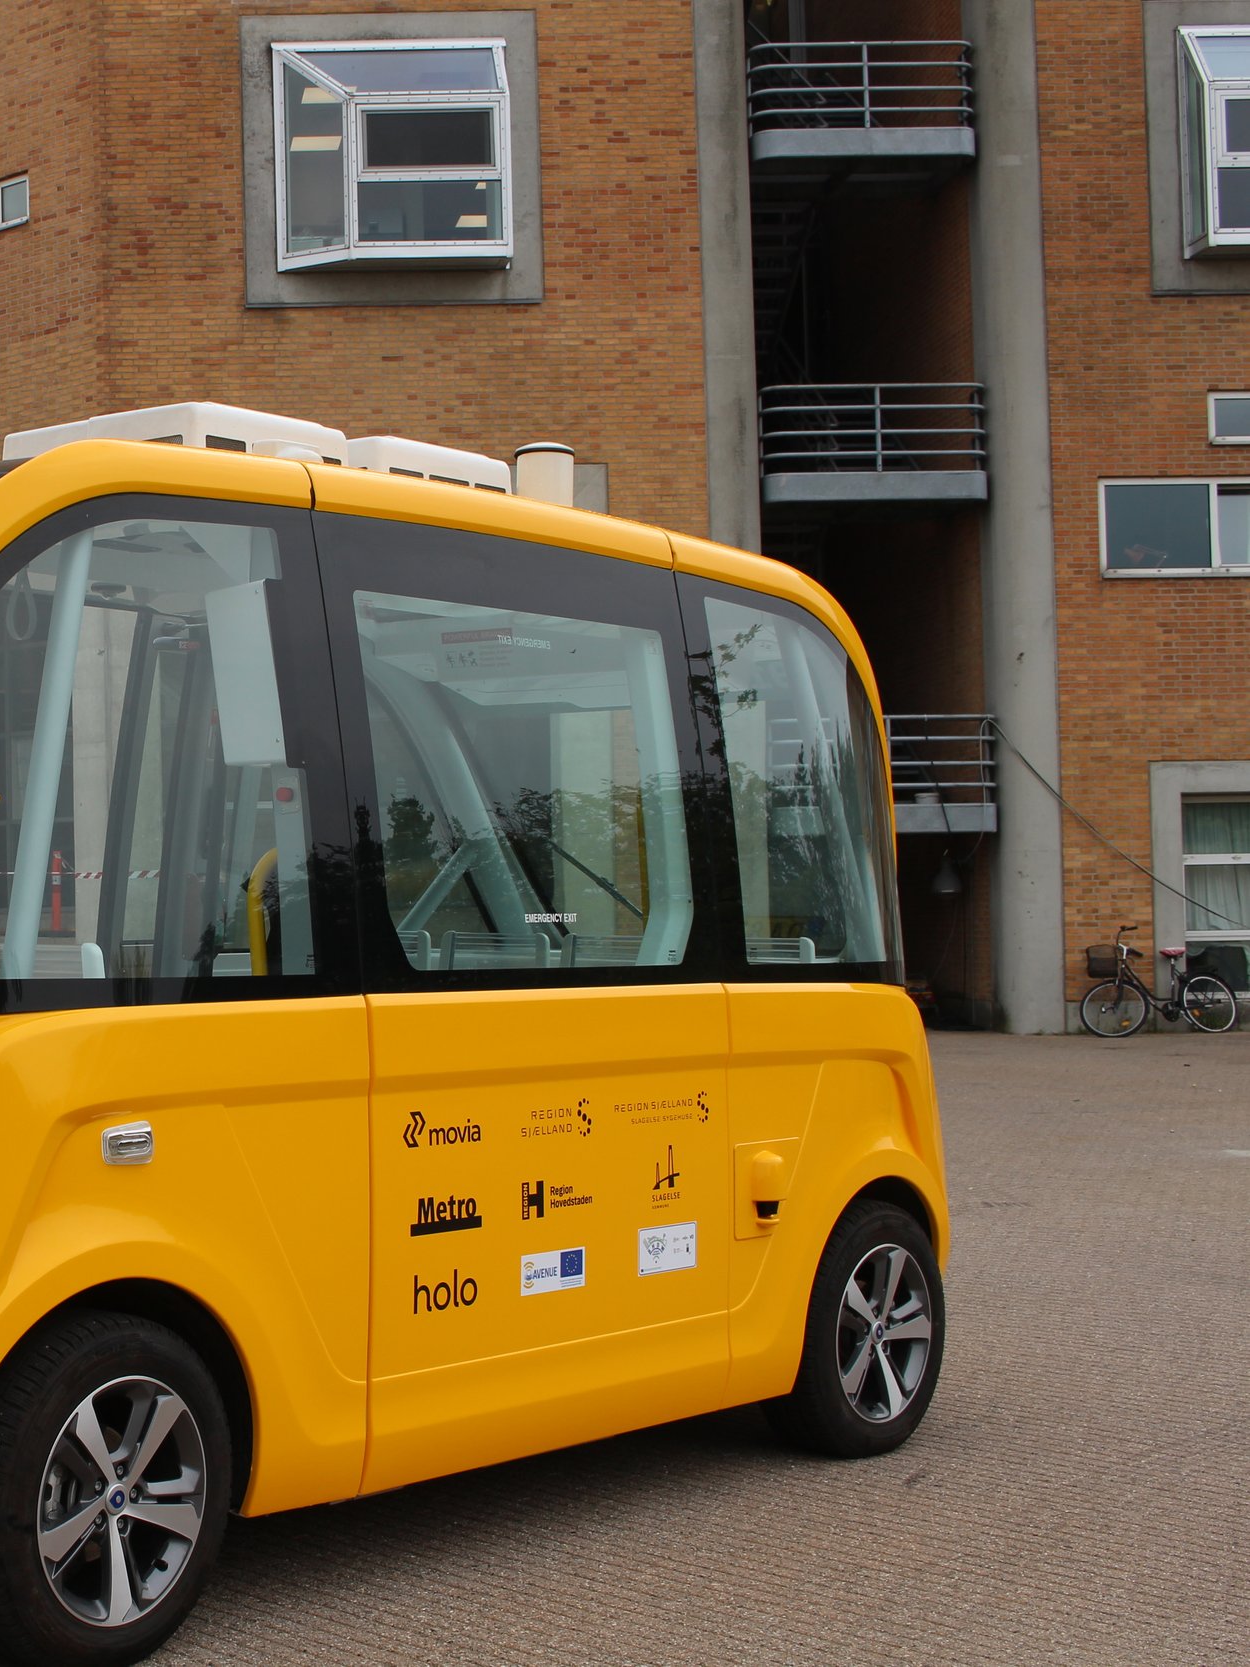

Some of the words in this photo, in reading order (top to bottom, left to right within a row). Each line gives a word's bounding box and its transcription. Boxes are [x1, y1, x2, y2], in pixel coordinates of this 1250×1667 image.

[524, 913, 563, 923] EMERGENCY
[563, 913, 578, 923] EXIT
[614, 1102, 649, 1113] REGION
[651, 1098, 694, 1110] SJÆLLAND
[531, 1107, 573, 1121] REGION
[631, 1116, 661, 1125] SLAGELSE
[429, 1118, 481, 1146] movia
[520, 1123, 573, 1138] SJÆLLAND
[550, 1184, 573, 1197] Region
[651, 1191, 681, 1203] SLAGELSE
[550, 1194, 593, 1209] Hovedstaden
[417, 1195, 477, 1224] Metro
[532, 1266, 558, 1280] AVENUE
[413, 1268, 478, 1314] holo
